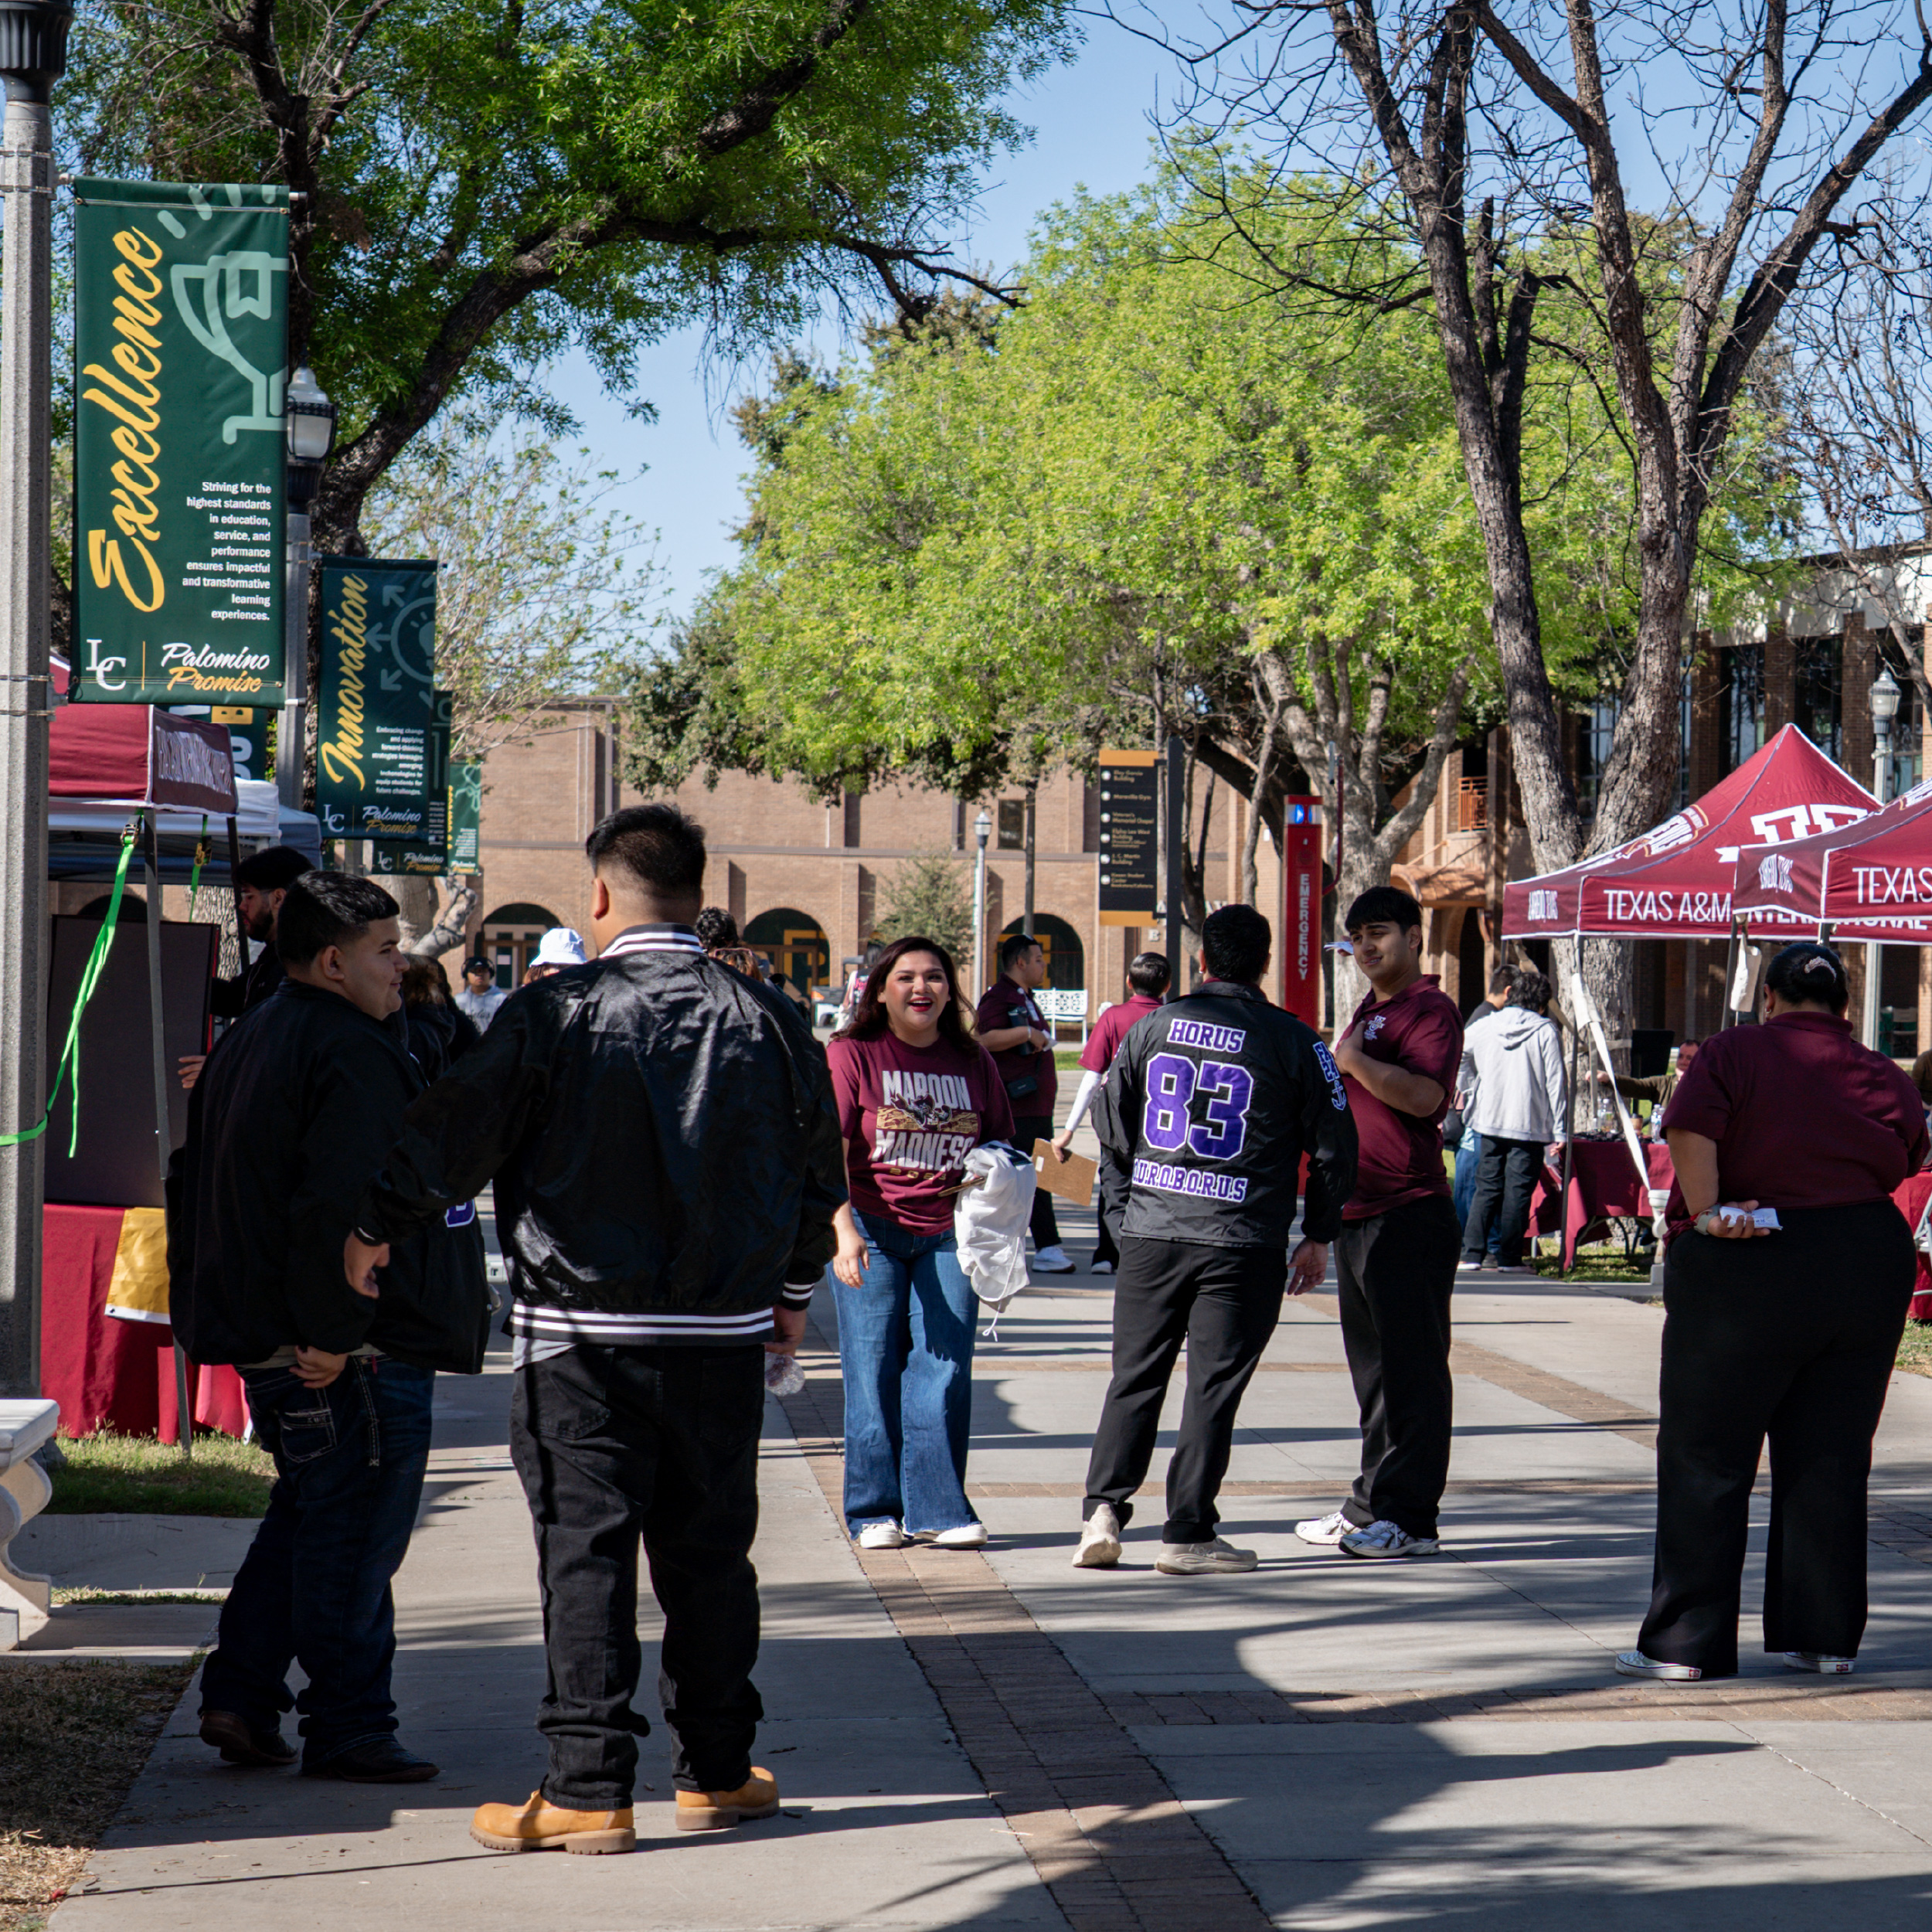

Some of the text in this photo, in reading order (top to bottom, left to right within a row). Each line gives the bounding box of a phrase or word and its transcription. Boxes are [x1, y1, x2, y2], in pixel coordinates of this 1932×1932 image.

[83, 226, 165, 612] Excellence
[202, 482, 271, 494] Striving for the
[186, 496, 271, 510] highest standards
[209, 513, 270, 527] in education,
[214, 530, 270, 542] service, and
[211, 546, 270, 557] performance
[186, 562, 270, 574] ensures impactful
[182, 577, 270, 589] and transformative
[232, 594, 270, 607] learning
[211, 610, 270, 621] experiences.
[161, 642, 270, 670] Palomino
[166, 666, 263, 692] Promise
[321, 573, 369, 791] Innovation
[376, 726, 404, 734] Embracing
[381, 743, 423, 753] forward-thinking
[380, 770, 416, 778] technologies
[362, 805, 422, 821] Palomino
[366, 820, 417, 834] Promise
[403, 852, 444, 864] Palomino
[406, 862, 441, 872] Promise
[1852, 866, 1932, 904] TEXAS
[1604, 889, 1673, 921] TEXAS
[1678, 891, 1731, 923] A&M
[1298, 873, 1310, 981] EMERGENCY
[1167, 1019, 1247, 1053] HORUS
[883, 1070, 971, 1110] MAROON
[1143, 1052, 1254, 1161] 83
